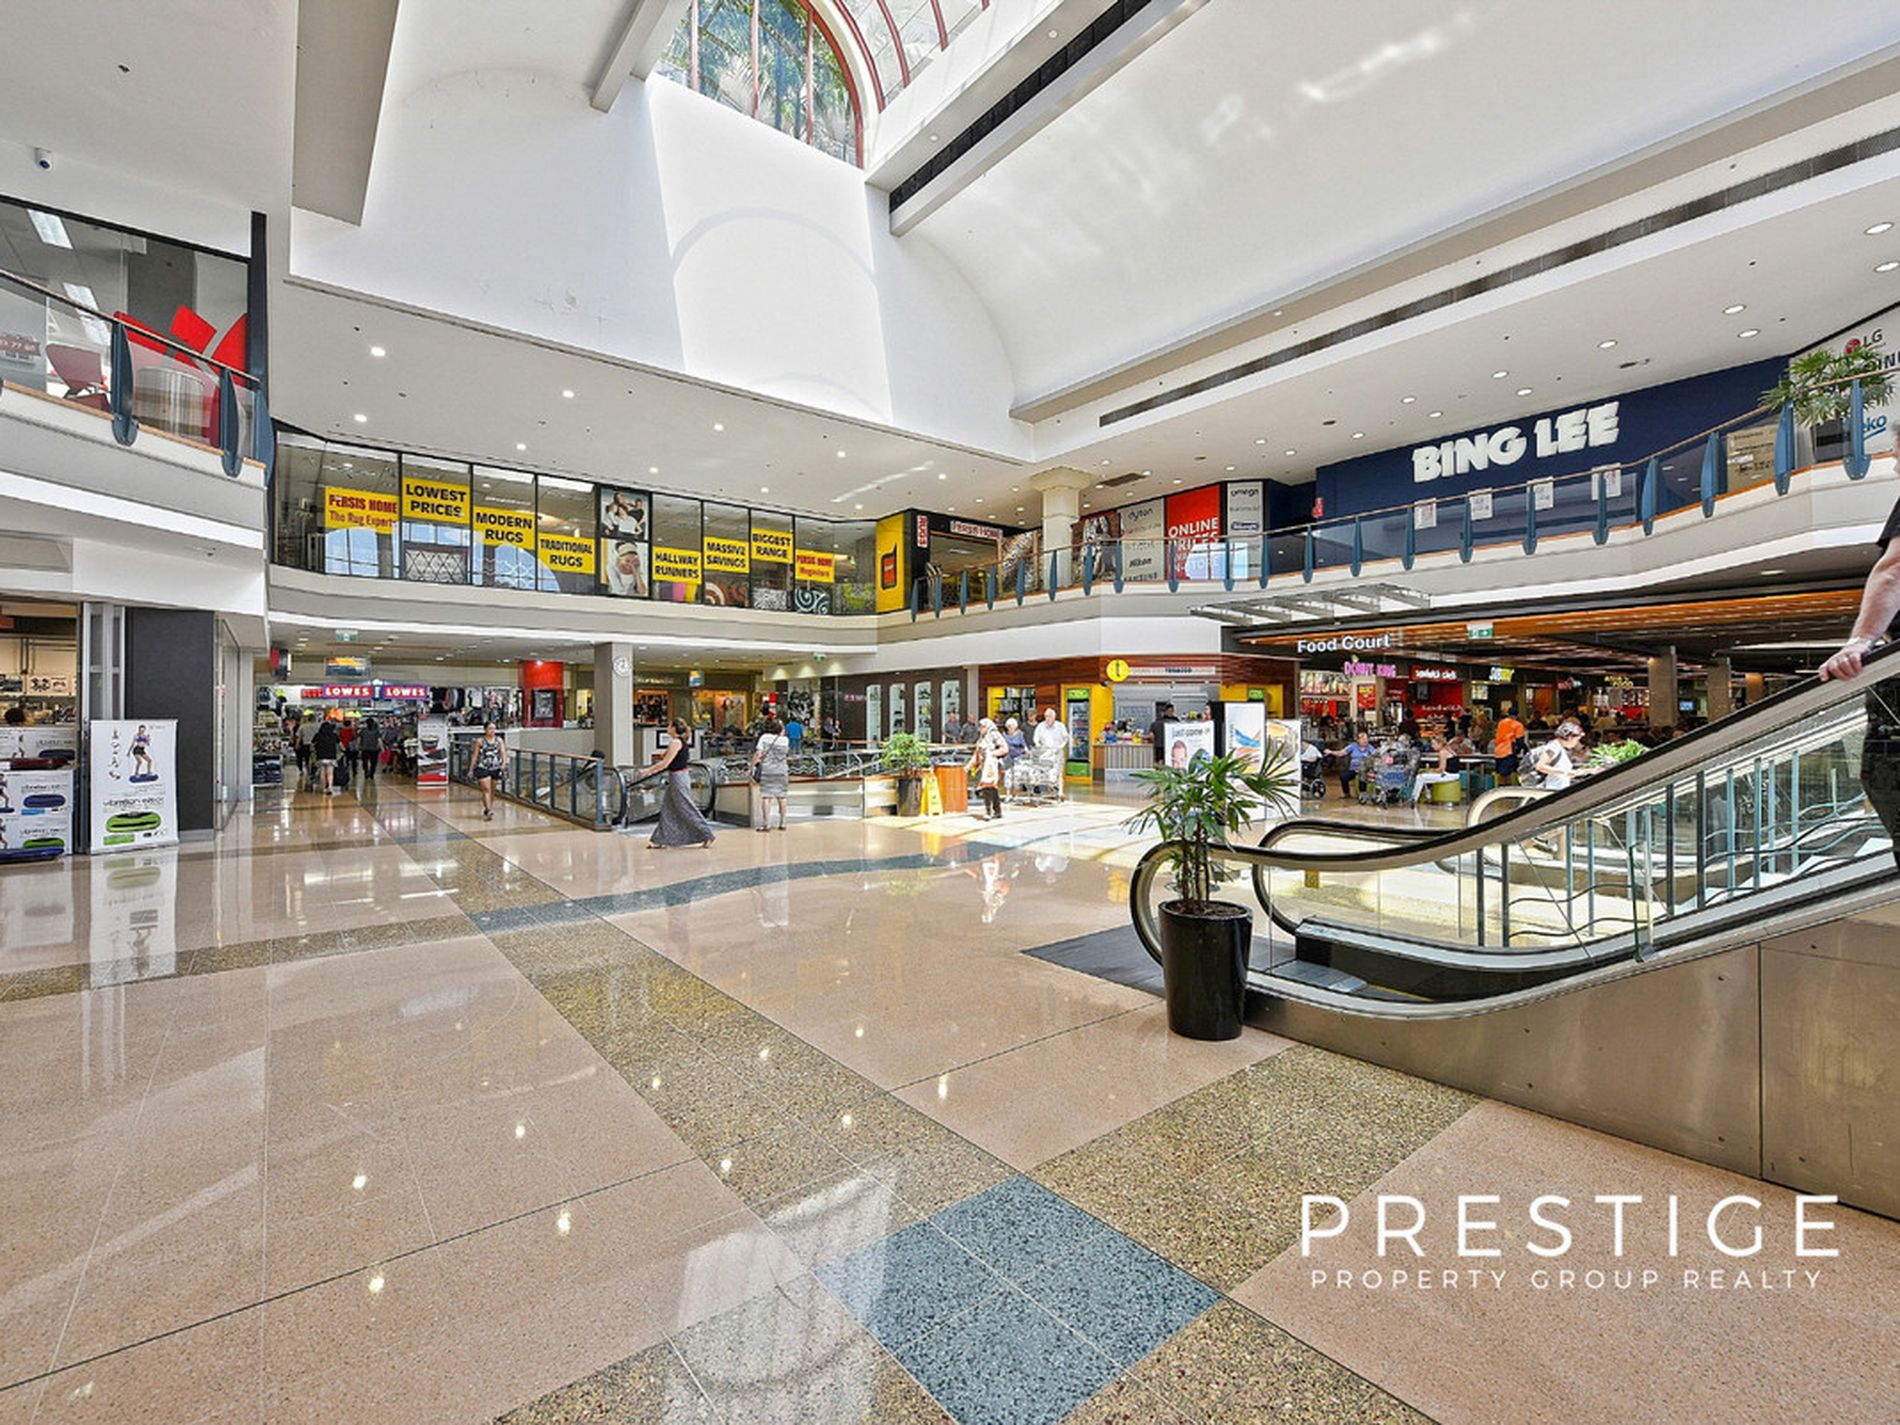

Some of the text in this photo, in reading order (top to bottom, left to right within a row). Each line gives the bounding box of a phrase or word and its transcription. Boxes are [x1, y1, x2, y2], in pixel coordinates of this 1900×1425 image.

[1863, 329, 1883, 347] LG
[1412, 401, 1620, 483] BING LEE
[405, 484, 467, 502] LOWEST
[1230, 488, 1260, 497] omega
[368, 499, 398, 514] HOME
[410, 500, 464, 517] PRICES
[329, 510, 346, 522] The
[347, 511, 364, 527] Rug
[475, 512, 533, 530] MODERN
[1168, 517, 1219, 537] ONLINE
[485, 528, 524, 544] RUGS
[752, 533, 791, 547] BIGGEST
[540, 537, 593, 555] TRADITIONAL
[706, 542, 746, 556] MASSIVE
[756, 545, 788, 558] RANGE
[549, 554, 584, 568] RUGS
[654, 551, 699, 567] HALLWAY
[706, 554, 746, 568] SAVINGS
[654, 564, 700, 579] RUNNERS
[1297, 632, 1391, 653] Food Court
[1376, 663, 1397, 678] KING
[324, 686, 370, 697] LOWES
[386, 687, 426, 697] LOWES
